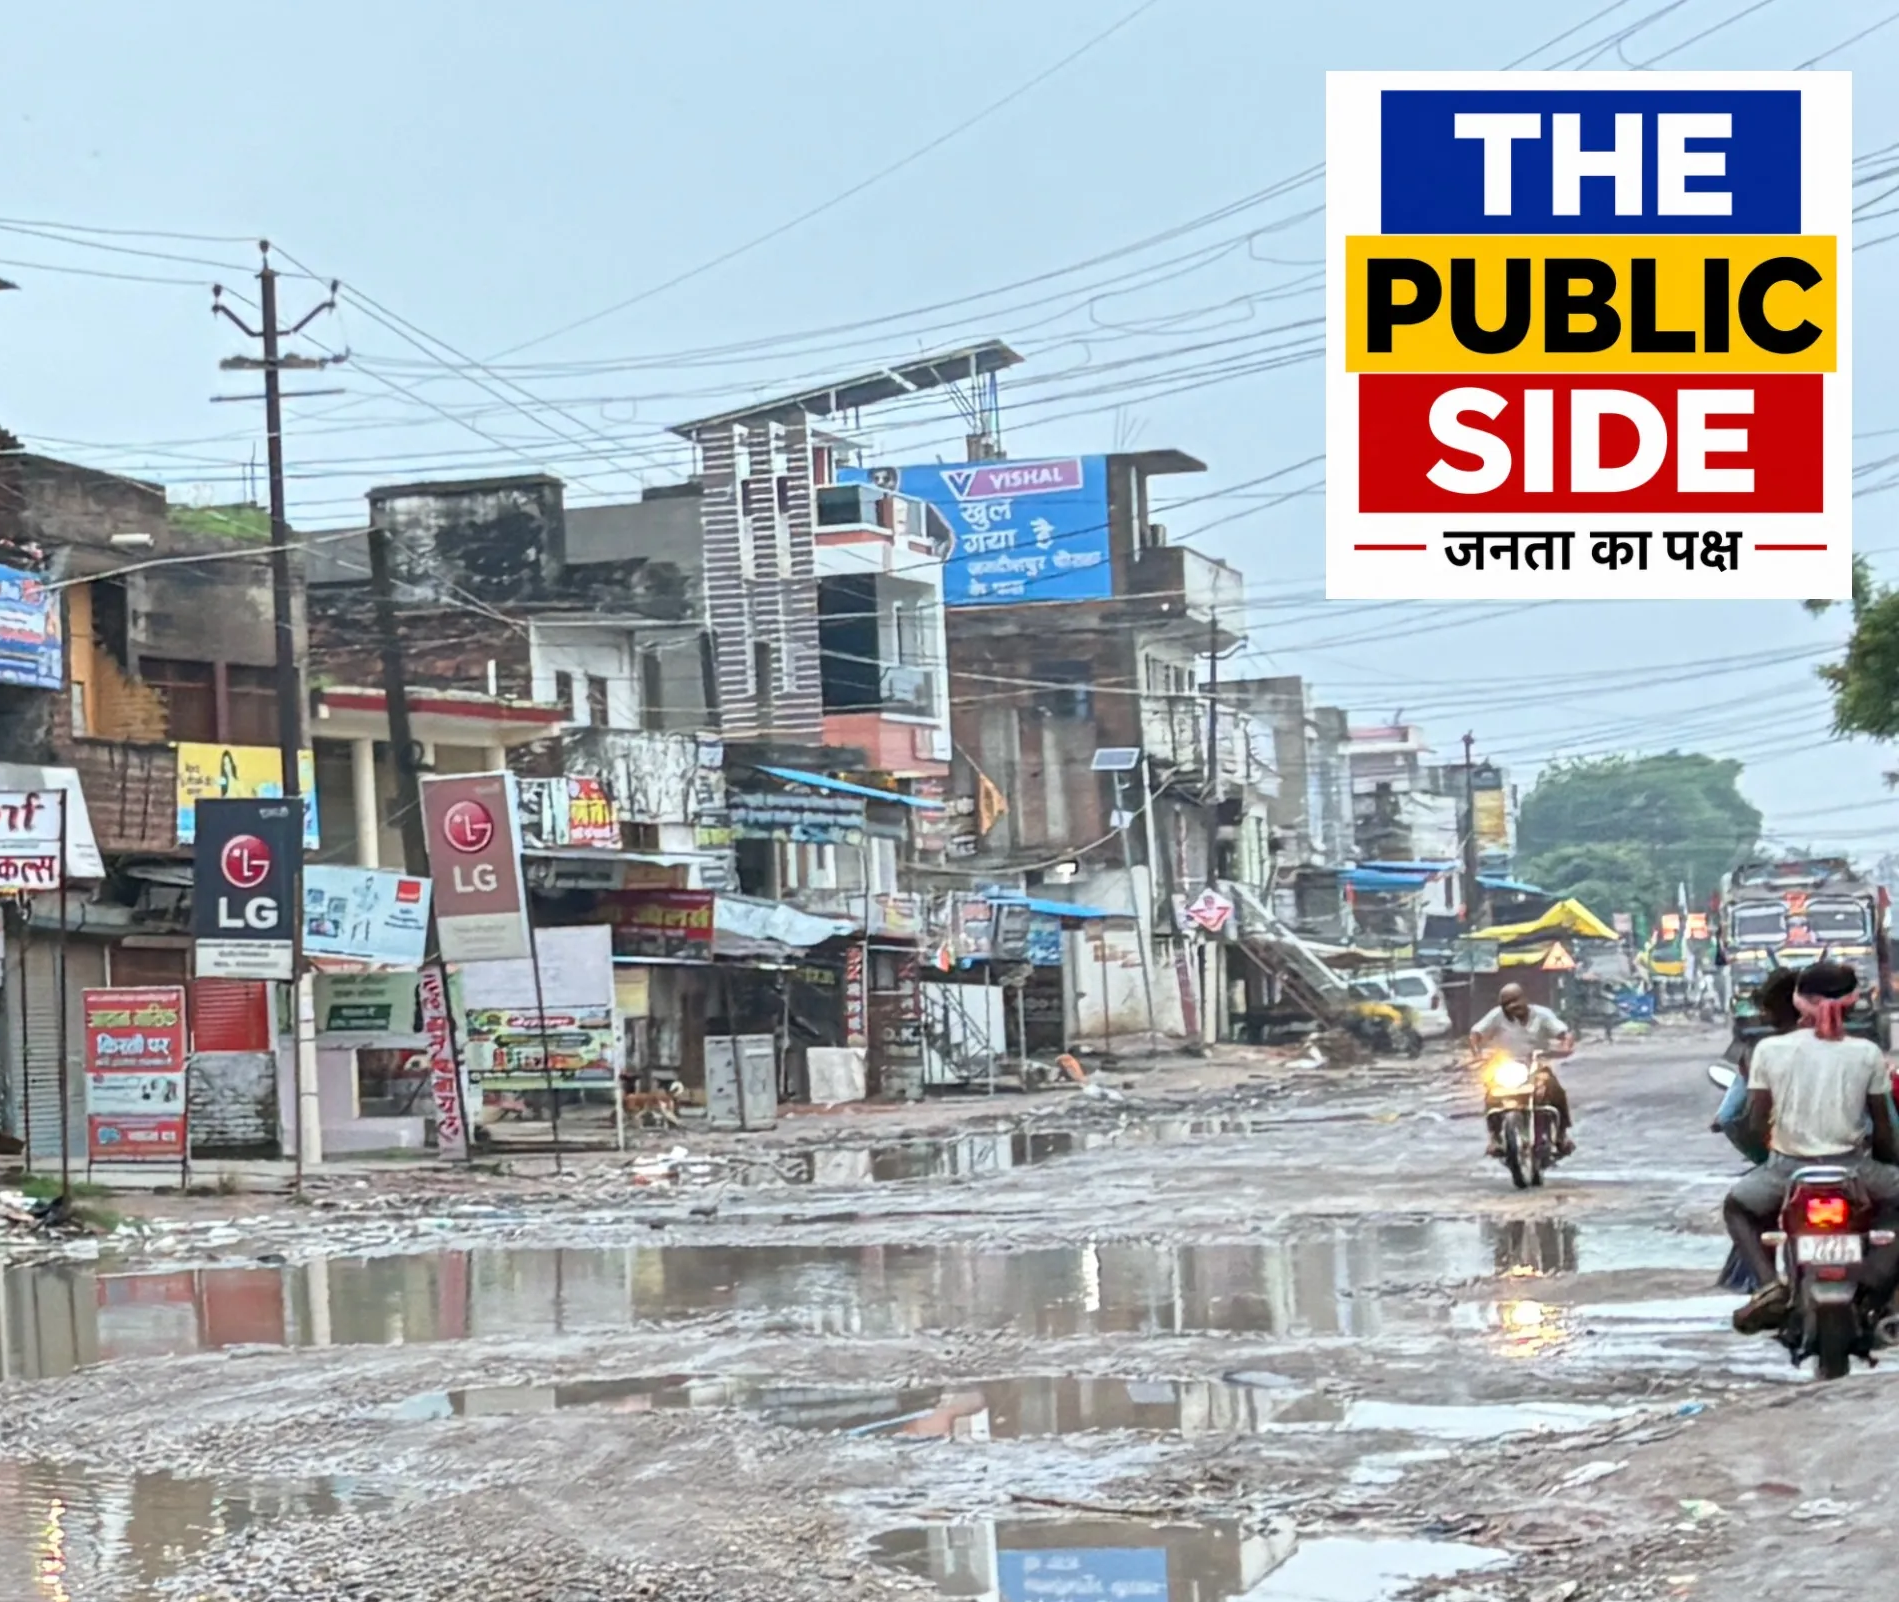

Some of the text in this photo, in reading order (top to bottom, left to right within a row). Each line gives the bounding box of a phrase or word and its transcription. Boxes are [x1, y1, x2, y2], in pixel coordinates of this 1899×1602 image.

[989, 466, 1064, 490] VISHAL
[958, 498, 1014, 532] खुल
[960, 517, 1055, 554] गया है
[453, 863, 498, 893] LG
[218, 896, 279, 929] LG
